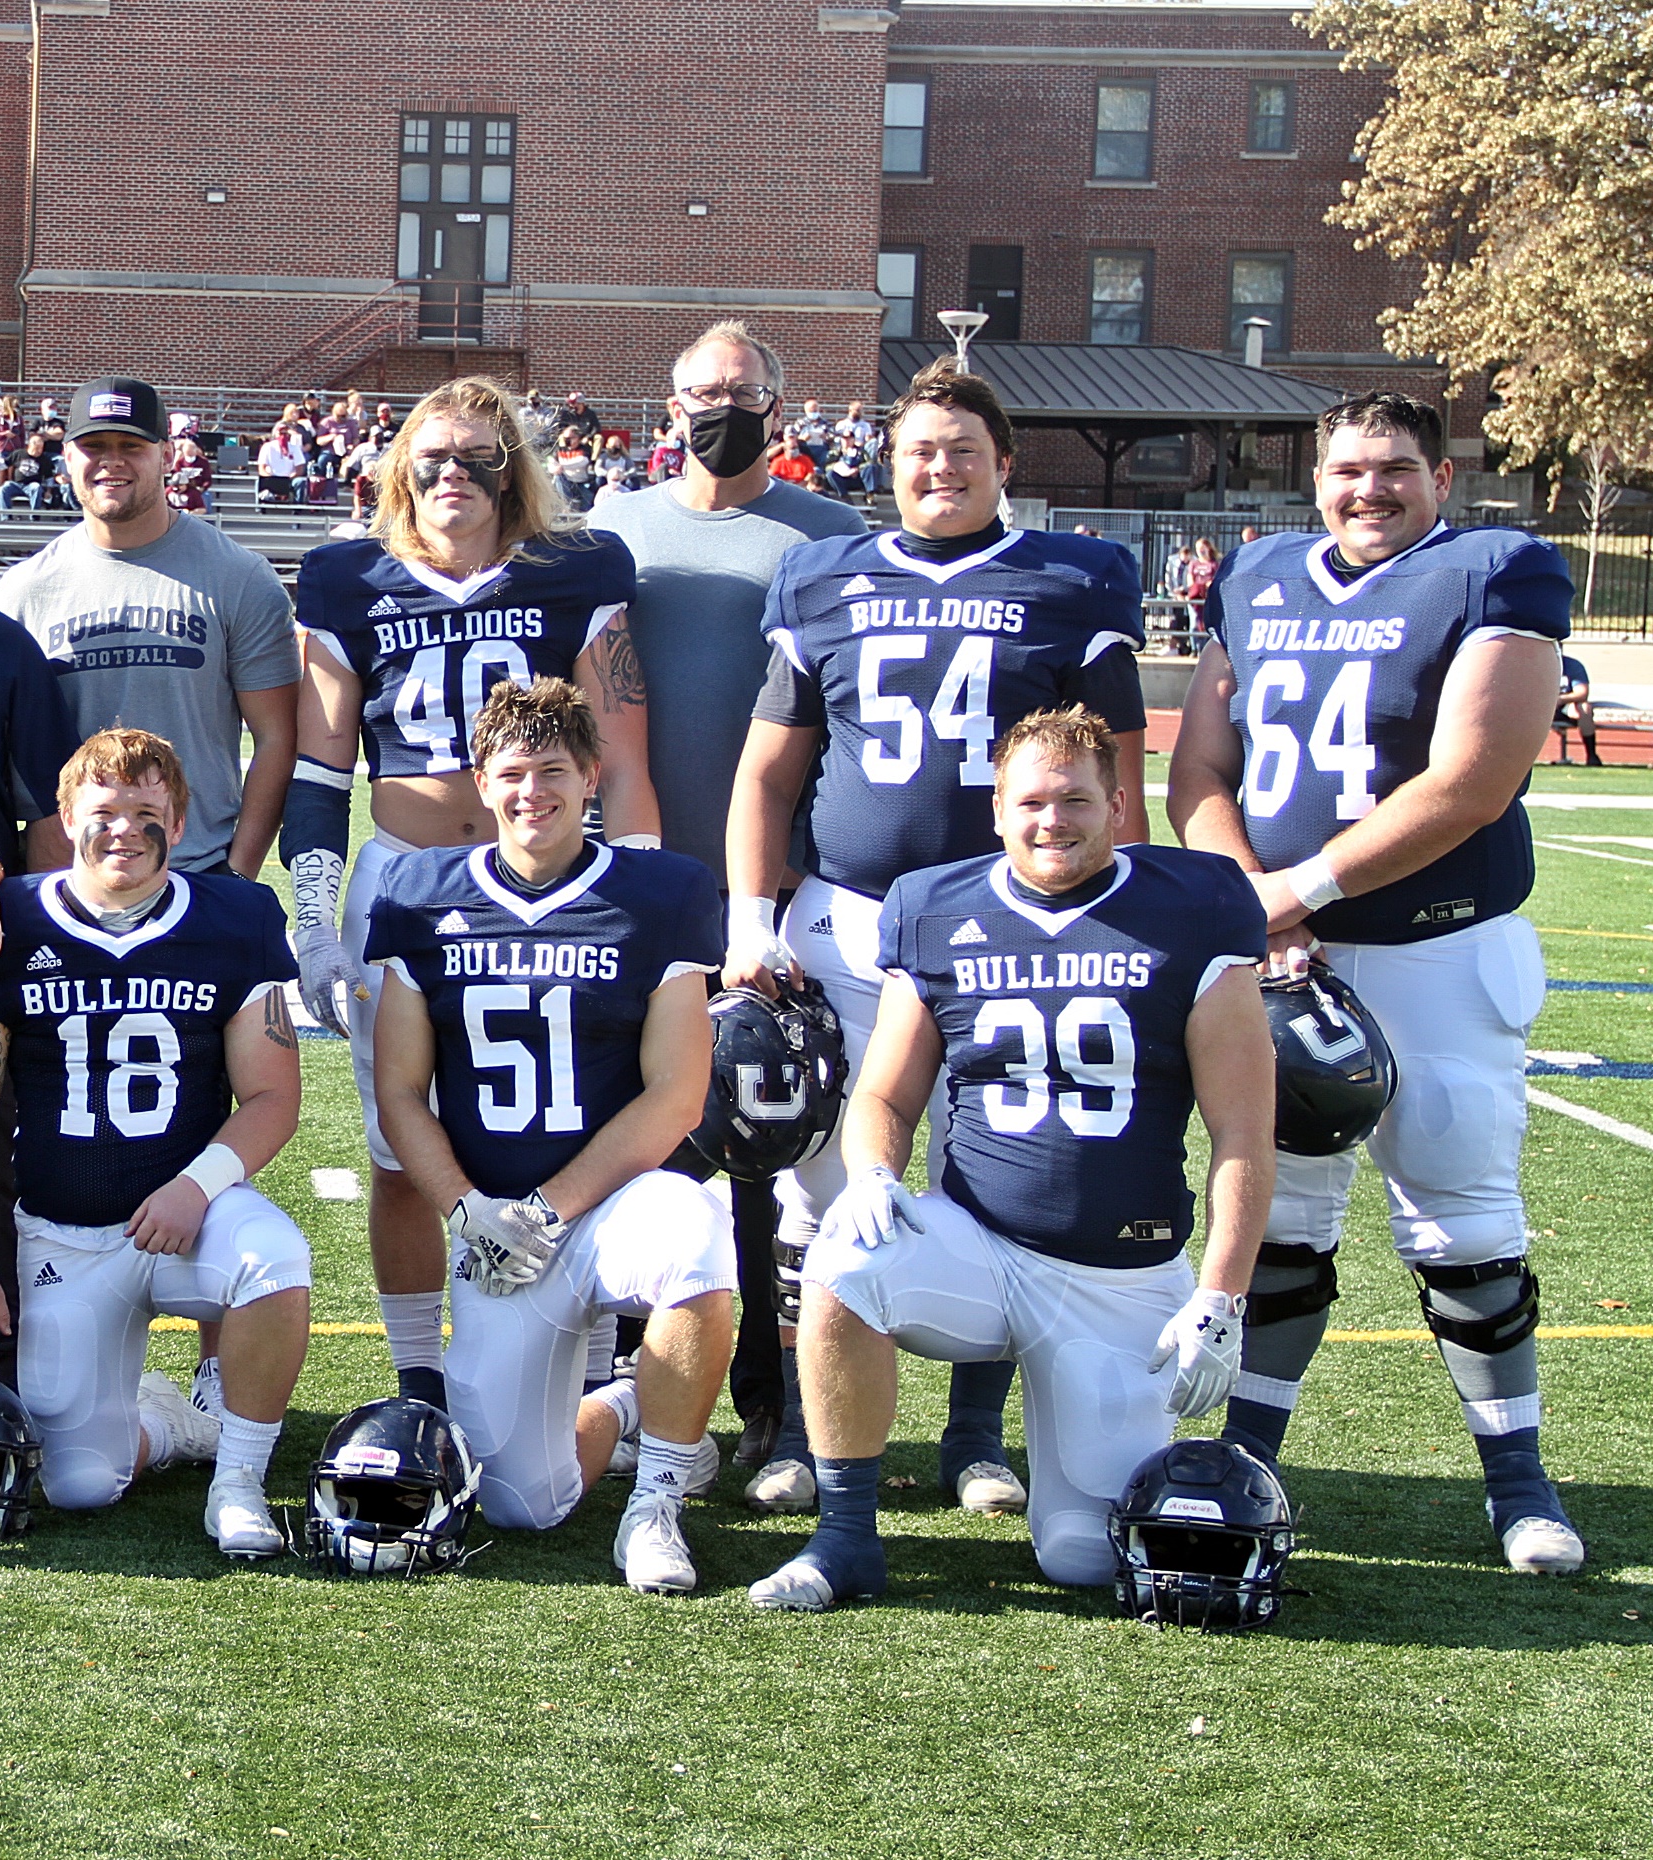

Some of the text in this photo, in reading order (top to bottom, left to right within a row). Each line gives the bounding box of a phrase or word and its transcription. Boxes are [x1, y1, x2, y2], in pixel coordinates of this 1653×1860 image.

[48, 605, 208, 654] BULLDOGS
[367, 605, 402, 618] adidas
[849, 598, 1025, 634] BULLDOGS
[374, 608, 543, 655] BULLDOGS
[1246, 617, 1406, 651] BULLDOGS
[74, 647, 177, 669] FOOTBALL
[394, 639, 534, 774] 40
[856, 634, 996, 786] 54
[1246, 659, 1376, 820] 64
[296, 854, 324, 931] BAYONETS
[435, 922, 470, 935] adidas
[1437, 910, 1450, 919] 2XL
[949, 933, 988, 946] adidas
[26, 957, 63, 971] adidas
[441, 942, 619, 980] BULLDOGS
[953, 952, 1151, 993] BULLDOGS
[21, 978, 217, 1015] BULLDOGS
[57, 1012, 181, 1138] 18
[463, 984, 583, 1133] 51
[974, 997, 1136, 1138] 39
[735, 1063, 807, 1121] C
[479, 1235, 499, 1271] adidas
[34, 1275, 64, 1288] adidas
[653, 1475, 678, 1486] adidas
